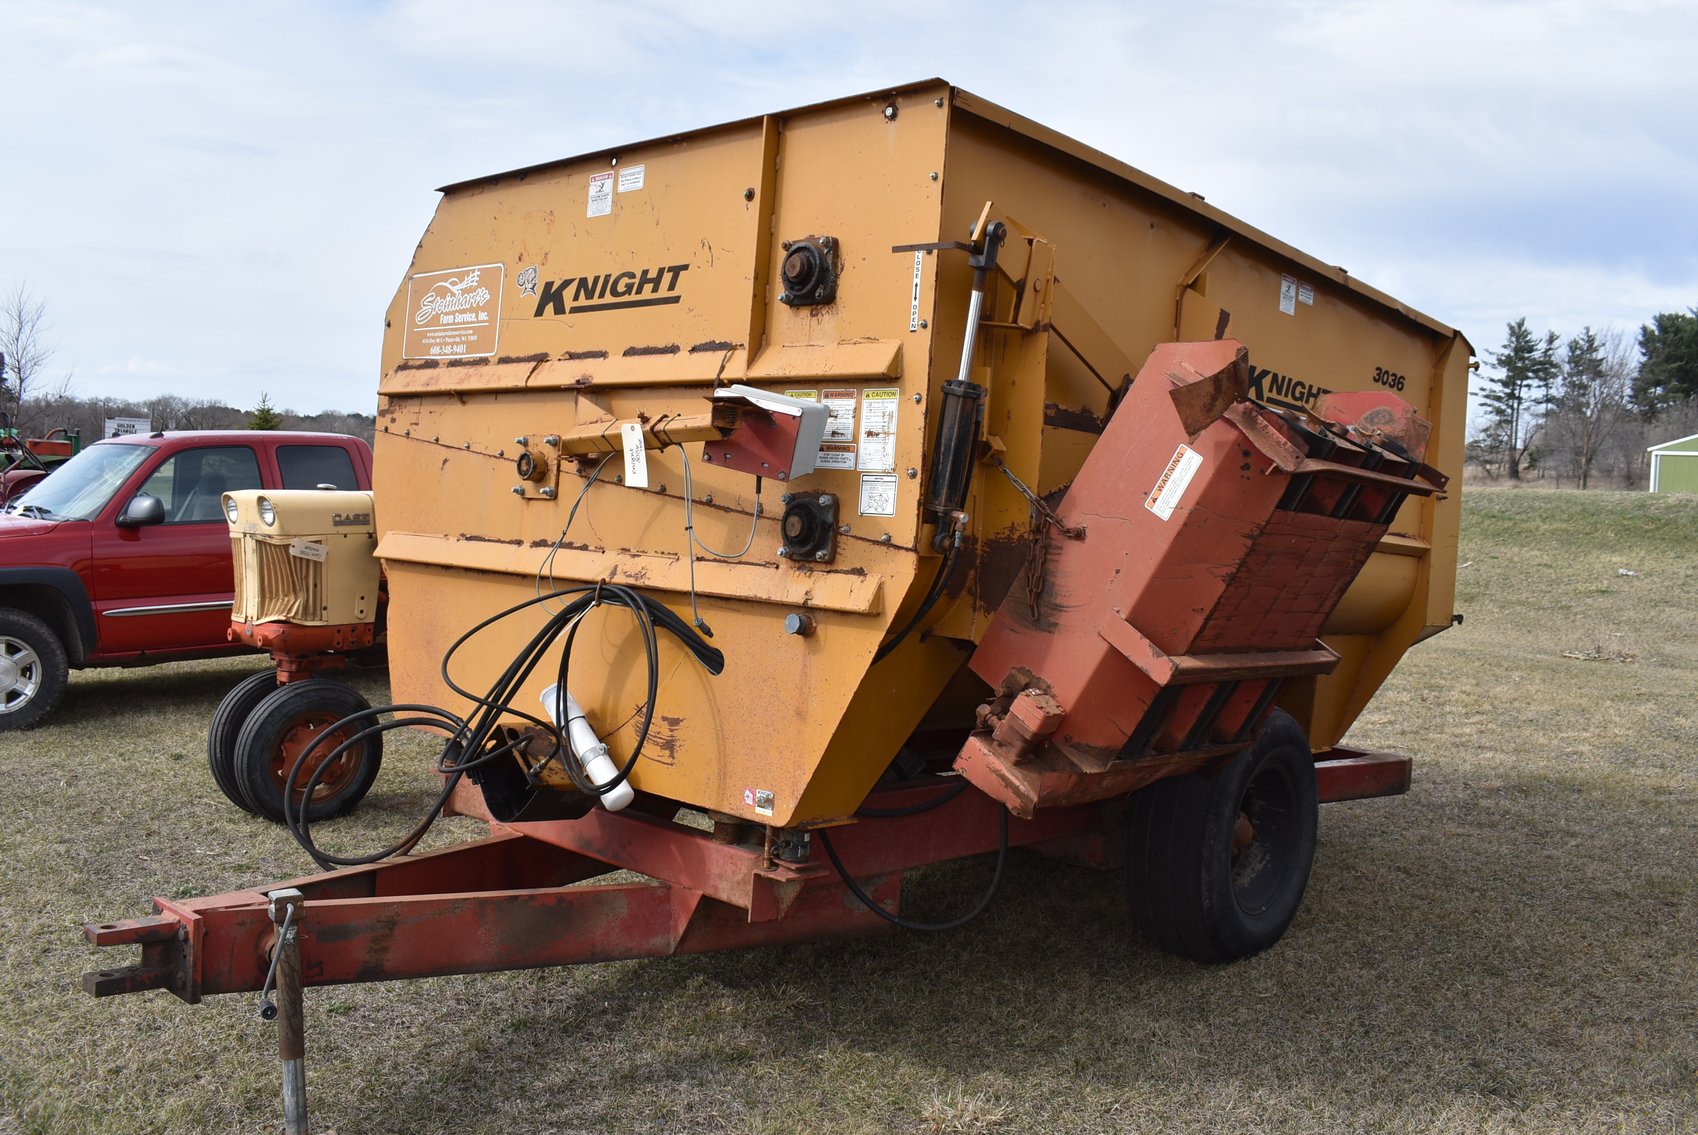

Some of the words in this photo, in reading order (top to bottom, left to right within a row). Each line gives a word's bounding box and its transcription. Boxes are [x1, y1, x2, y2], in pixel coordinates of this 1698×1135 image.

[534, 264, 690, 318] KNIGHT
[440, 312, 454, 324] Farm
[910, 304, 918, 329] OPEN
[1372, 366, 1406, 391] 3036
[829, 390, 855, 399] WARNING
[1157, 451, 1184, 492] WARNING
[332, 513, 370, 522] CASE
